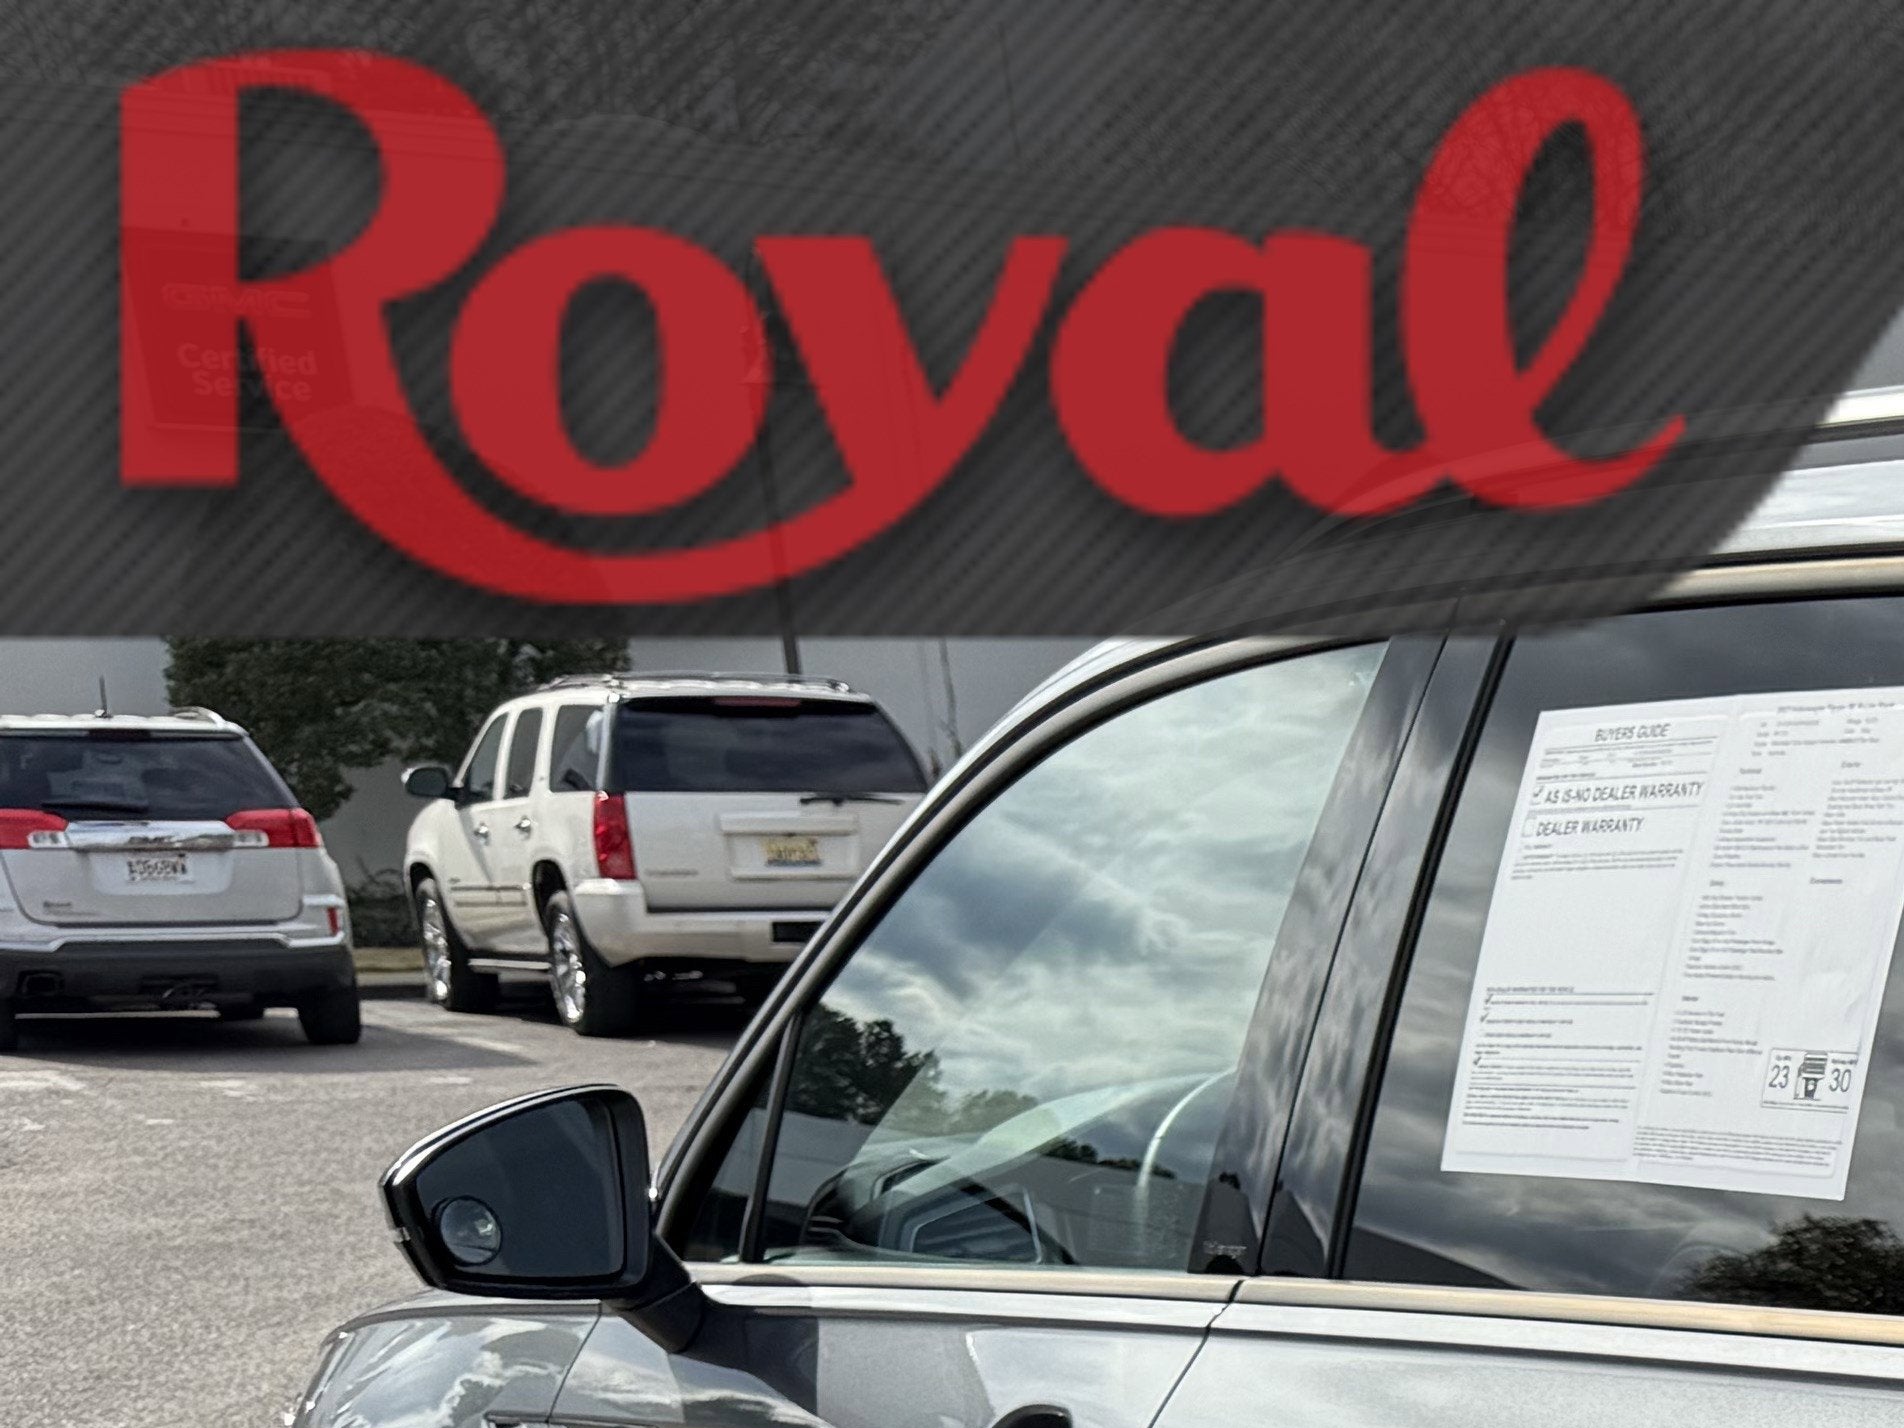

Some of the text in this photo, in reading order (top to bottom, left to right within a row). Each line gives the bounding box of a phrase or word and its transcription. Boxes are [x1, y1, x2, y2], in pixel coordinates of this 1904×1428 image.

[1594, 723, 1672, 742] BUYERS GUIDE
[1544, 788, 1560, 804] AS
[1592, 784, 1639, 801] DEALER
[1639, 781, 1705, 799] WARRANTY
[1535, 816, 1645, 837] DEALER WARRANTY
[1768, 1064, 1791, 1089] 23
[1828, 1067, 1852, 1093] 30
